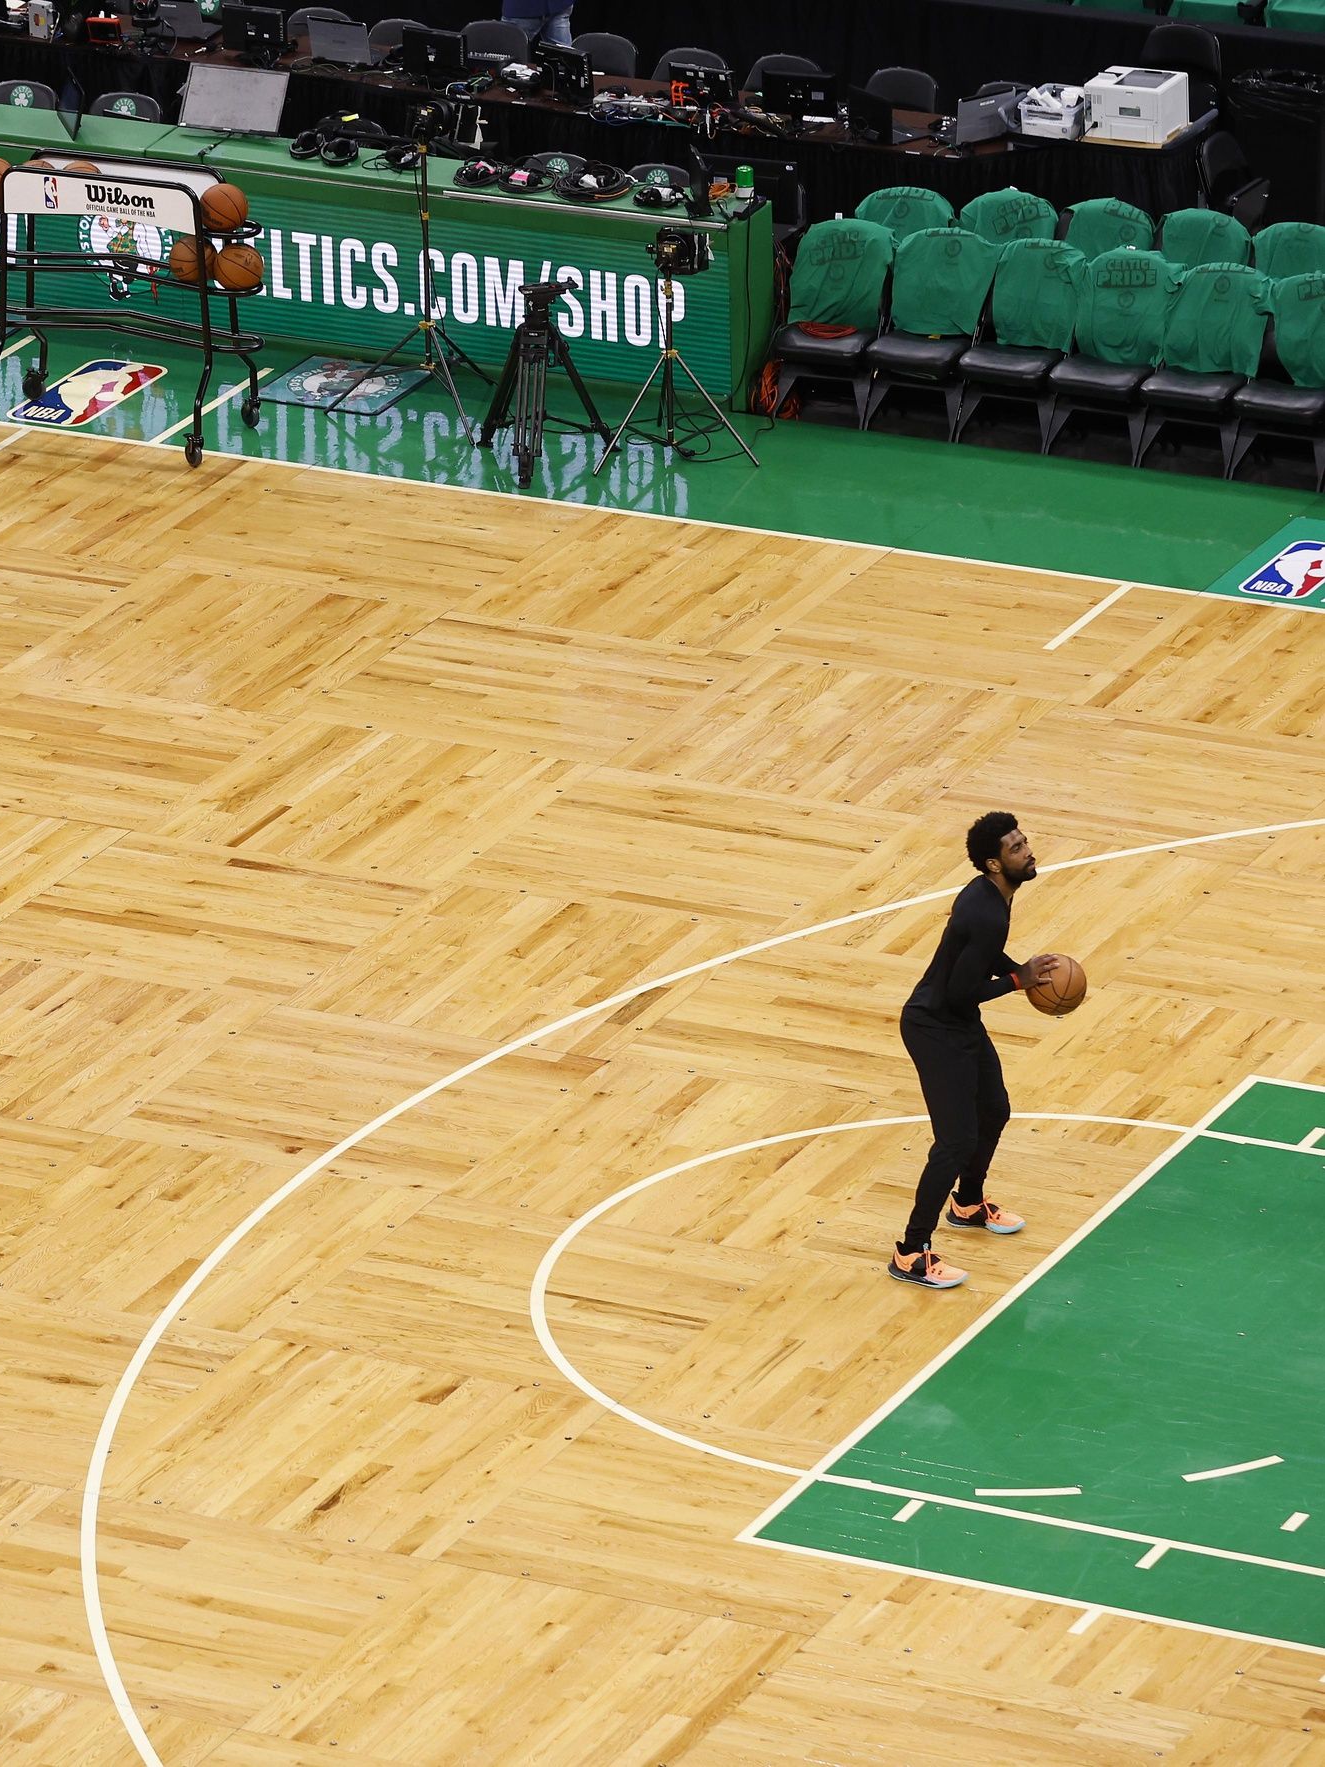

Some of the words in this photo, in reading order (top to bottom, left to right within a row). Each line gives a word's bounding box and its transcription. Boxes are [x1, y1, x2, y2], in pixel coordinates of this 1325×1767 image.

[85, 184, 155, 209] Wilson
[86, 204, 106, 213] OFFICIAL
[106, 206, 118, 214] GAME
[119, 207, 130, 215] BALL
[146, 210, 155, 218] NBA
[212, 227, 686, 349] LTICS.COMSHOP
[1097, 269, 1157, 288] PRIDE
[291, 368, 323, 391] BOSTON
[20, 405, 66, 420] NBA
[1249, 580, 1288, 594] NBA
